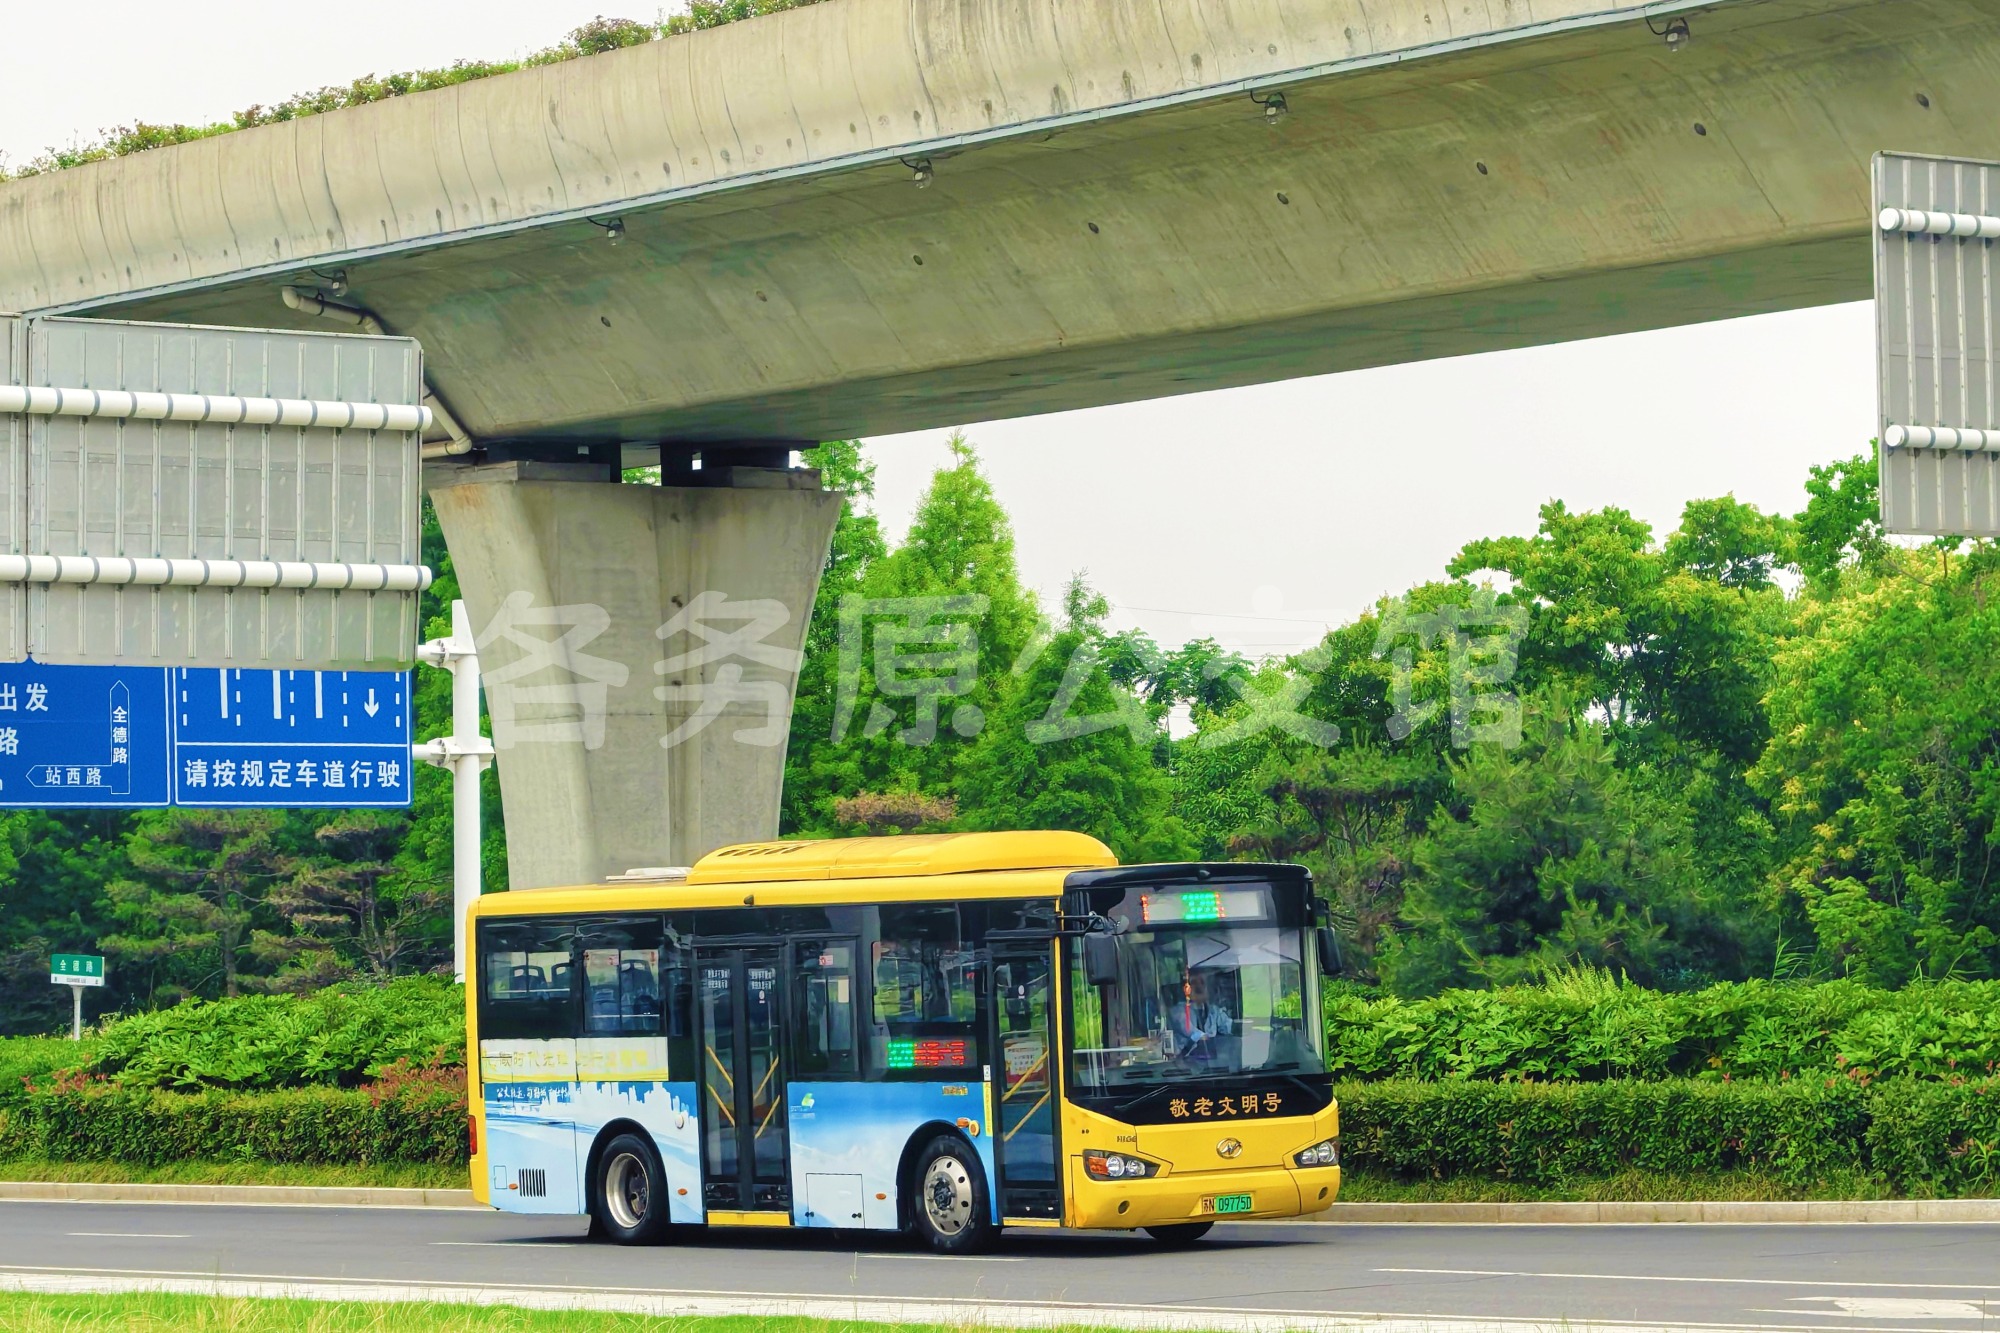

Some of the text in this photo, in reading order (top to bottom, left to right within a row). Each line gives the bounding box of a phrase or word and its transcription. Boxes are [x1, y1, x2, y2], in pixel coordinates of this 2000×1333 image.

[112, 706, 128, 764] 全德路
[45, 766, 102, 787] 站西路
[184, 758, 401, 789] 请按规定车道行驶
[1169, 1092, 1282, 1118] 敬老文明号
